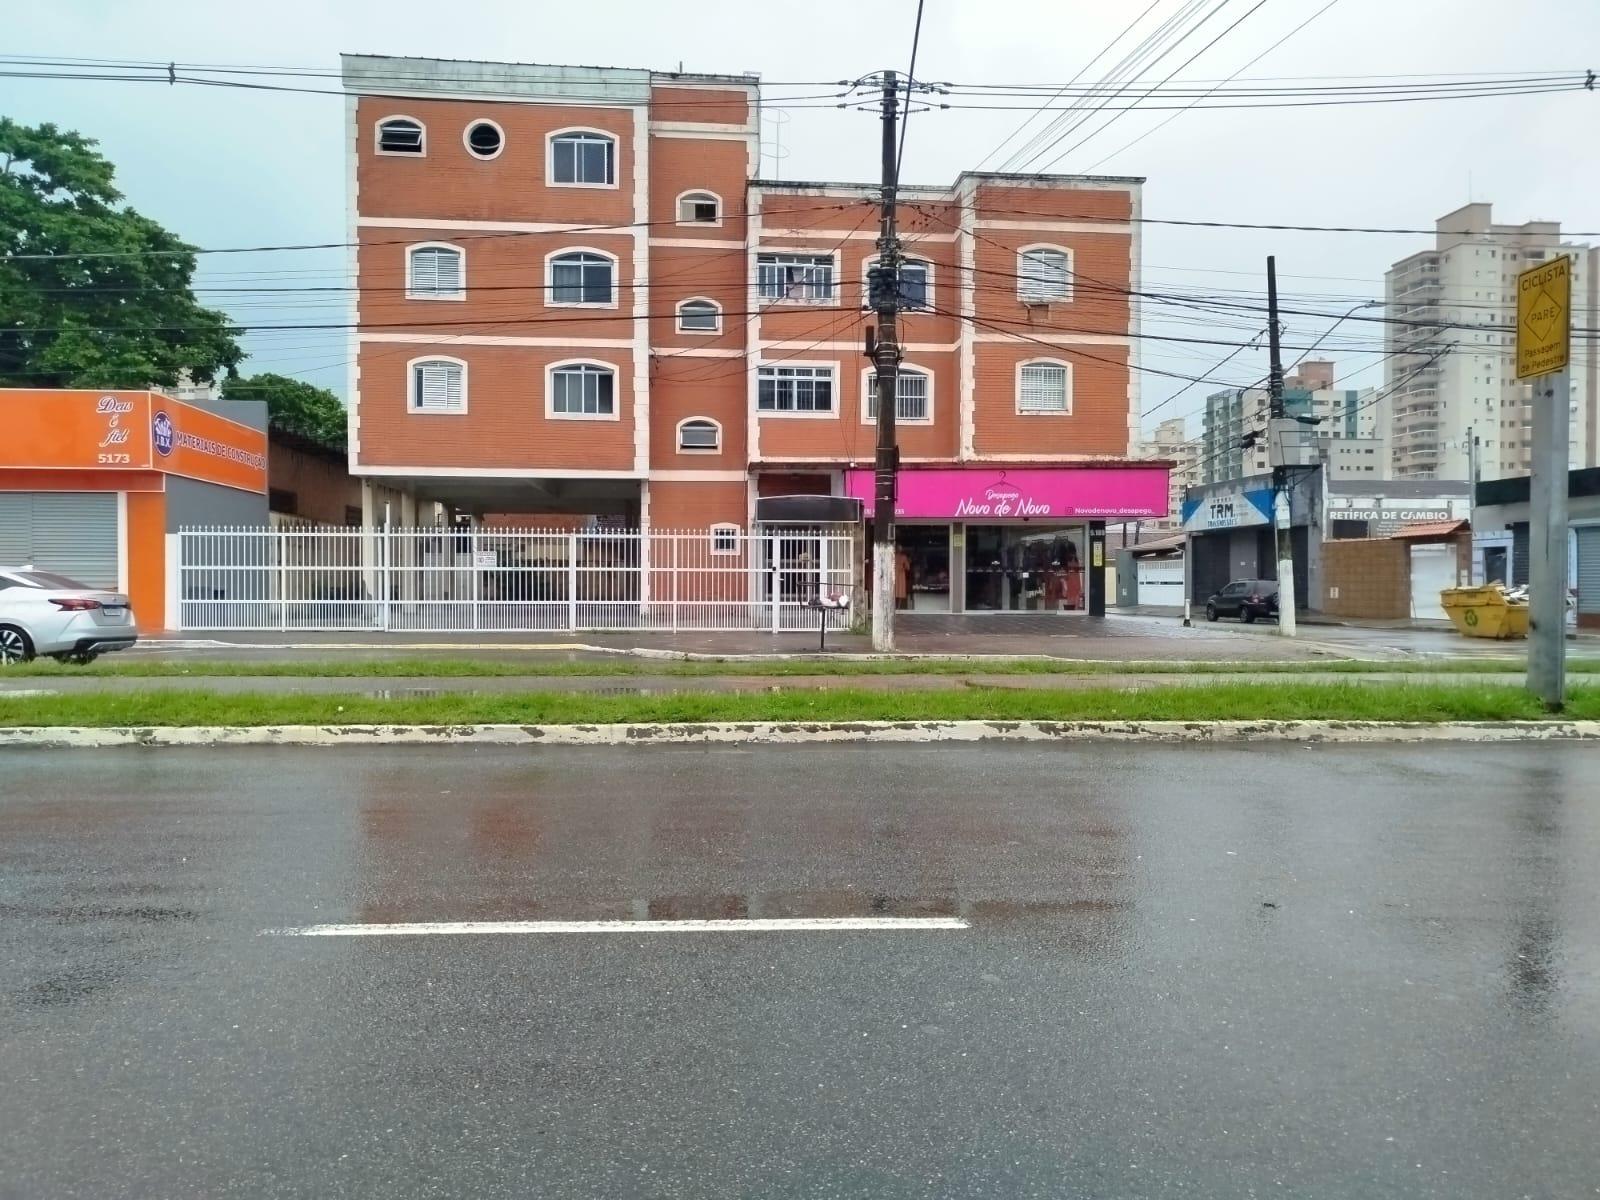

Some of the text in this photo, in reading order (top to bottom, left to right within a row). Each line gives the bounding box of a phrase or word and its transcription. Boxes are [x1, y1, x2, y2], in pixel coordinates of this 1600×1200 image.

[1522, 266, 1565, 291] CICLISTA
[1531, 307, 1555, 323] PARE
[96, 396, 133, 413] Deus
[98, 453, 130, 463] 5173
[175, 430, 267, 471] MATERIAIS DE CONSTRUÇÃO
[955, 497, 1050, 517] Novo de Novo
[1210, 504, 1233, 519] TRM
[1329, 509, 1378, 520] RETÍFICA
[1382, 511, 1397, 520] DE
